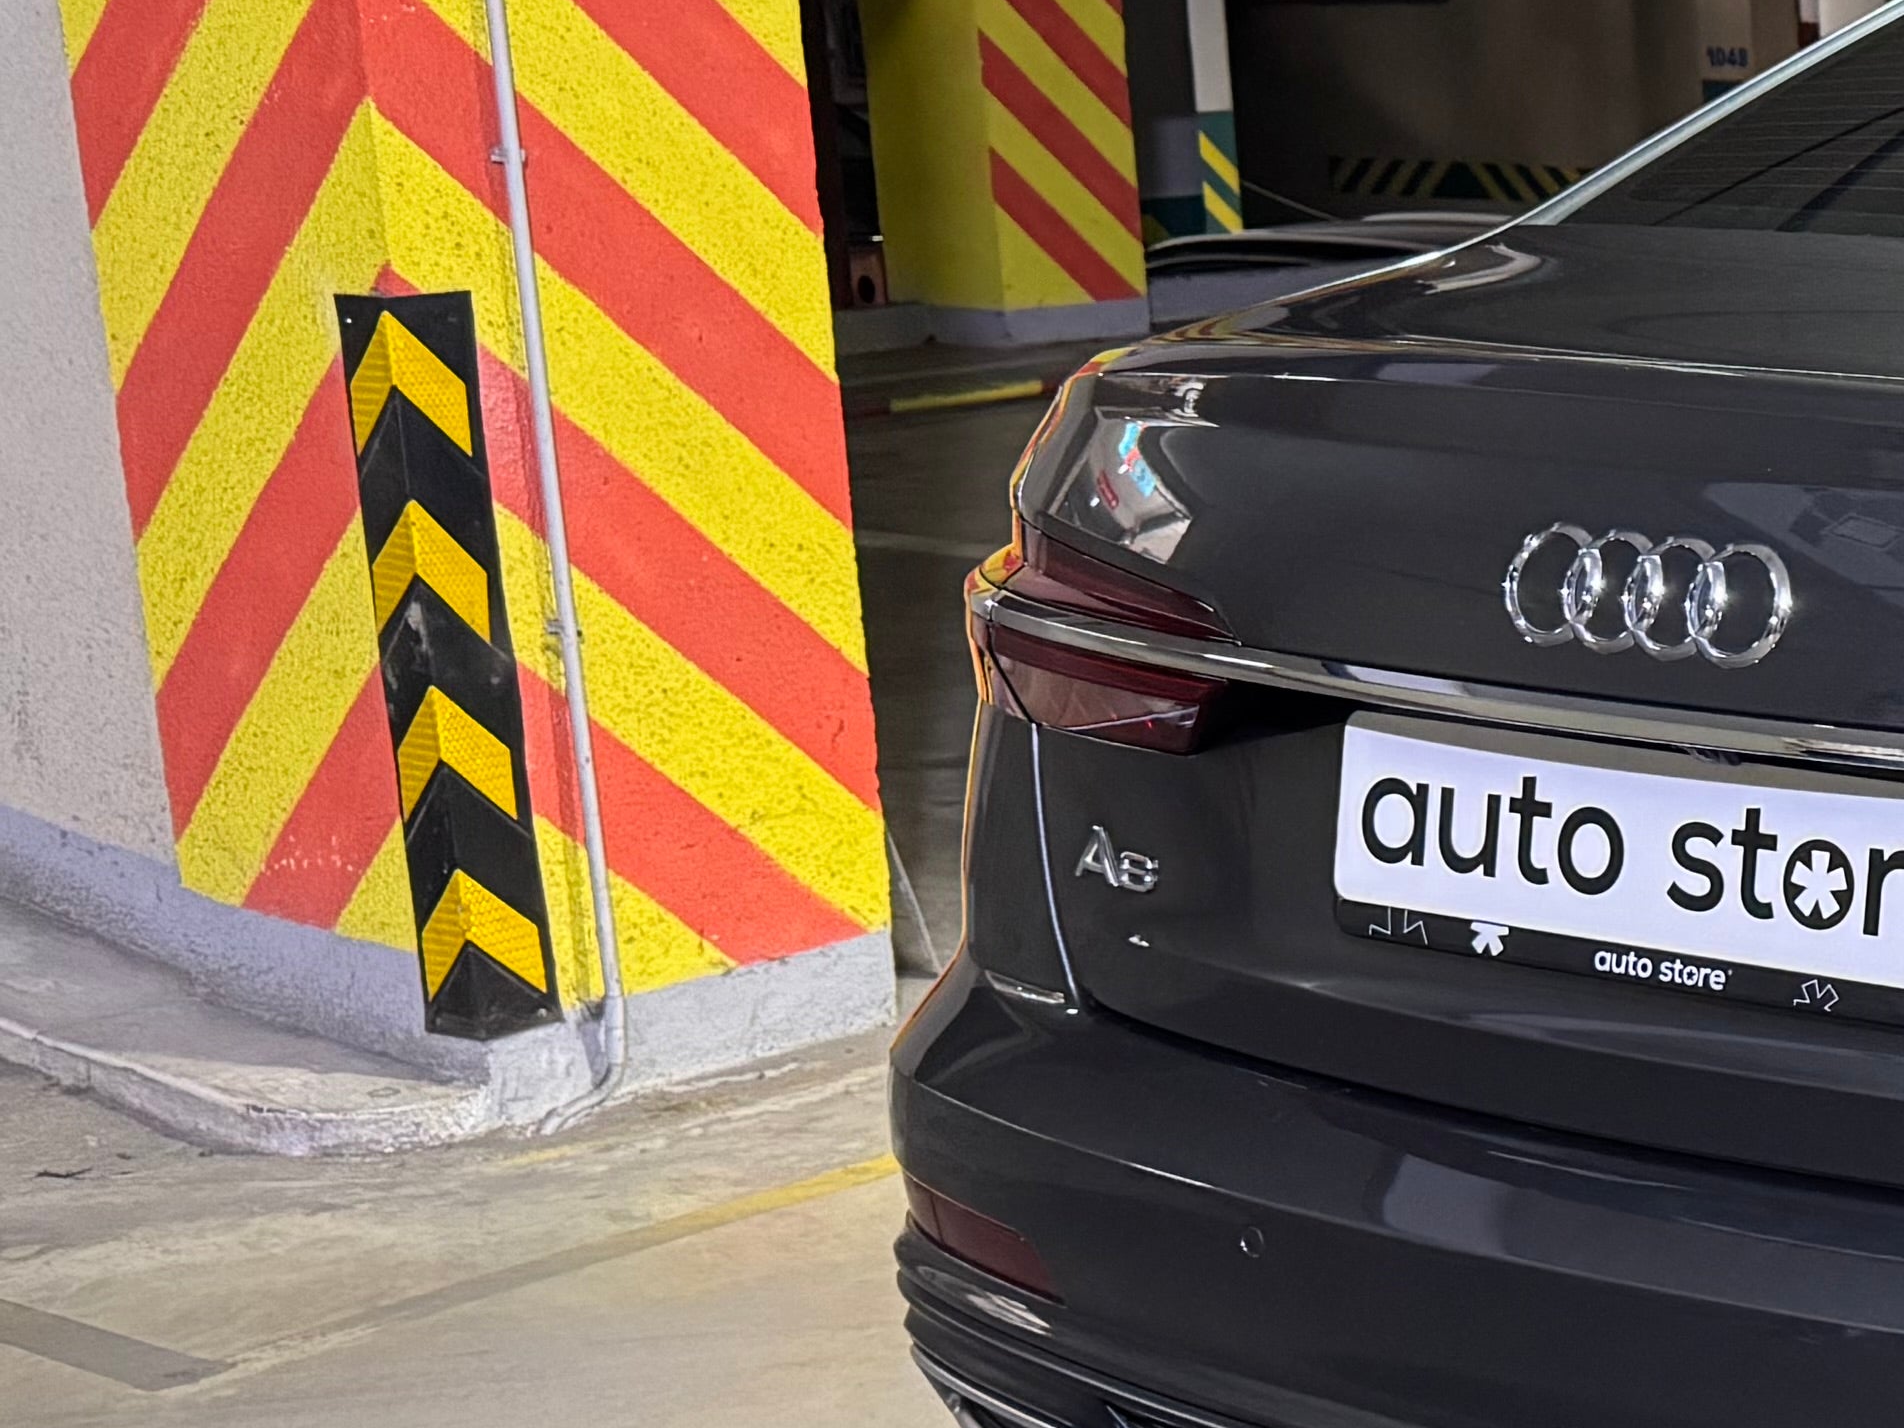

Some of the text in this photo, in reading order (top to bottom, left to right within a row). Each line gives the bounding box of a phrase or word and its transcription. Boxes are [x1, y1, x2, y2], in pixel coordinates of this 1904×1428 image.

[1361, 775, 1625, 896] auto
[1594, 950, 1726, 991] auto store
